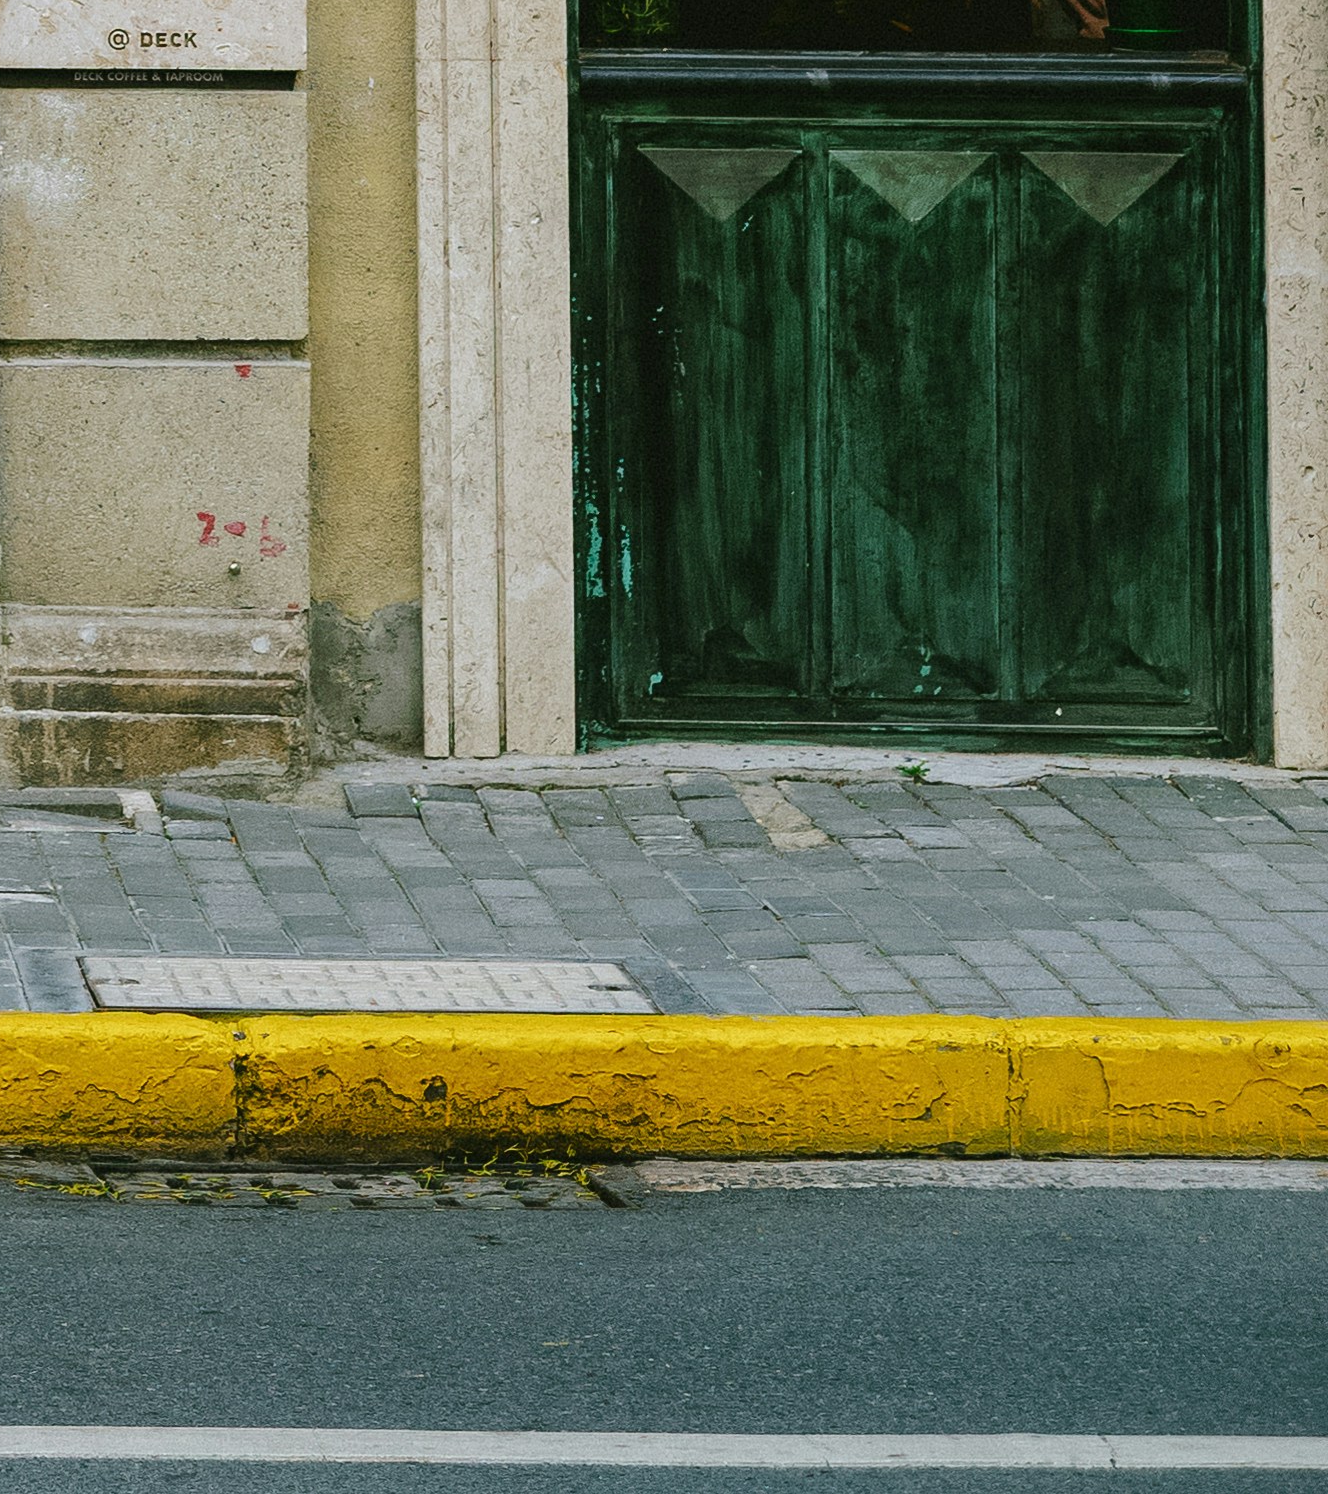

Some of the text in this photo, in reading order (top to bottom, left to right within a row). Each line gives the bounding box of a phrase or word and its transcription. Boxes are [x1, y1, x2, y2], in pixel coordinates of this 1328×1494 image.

[108, 29, 197, 50] @ DECK
[74, 72, 224, 82] DECK COFFEE & TAPROOM
